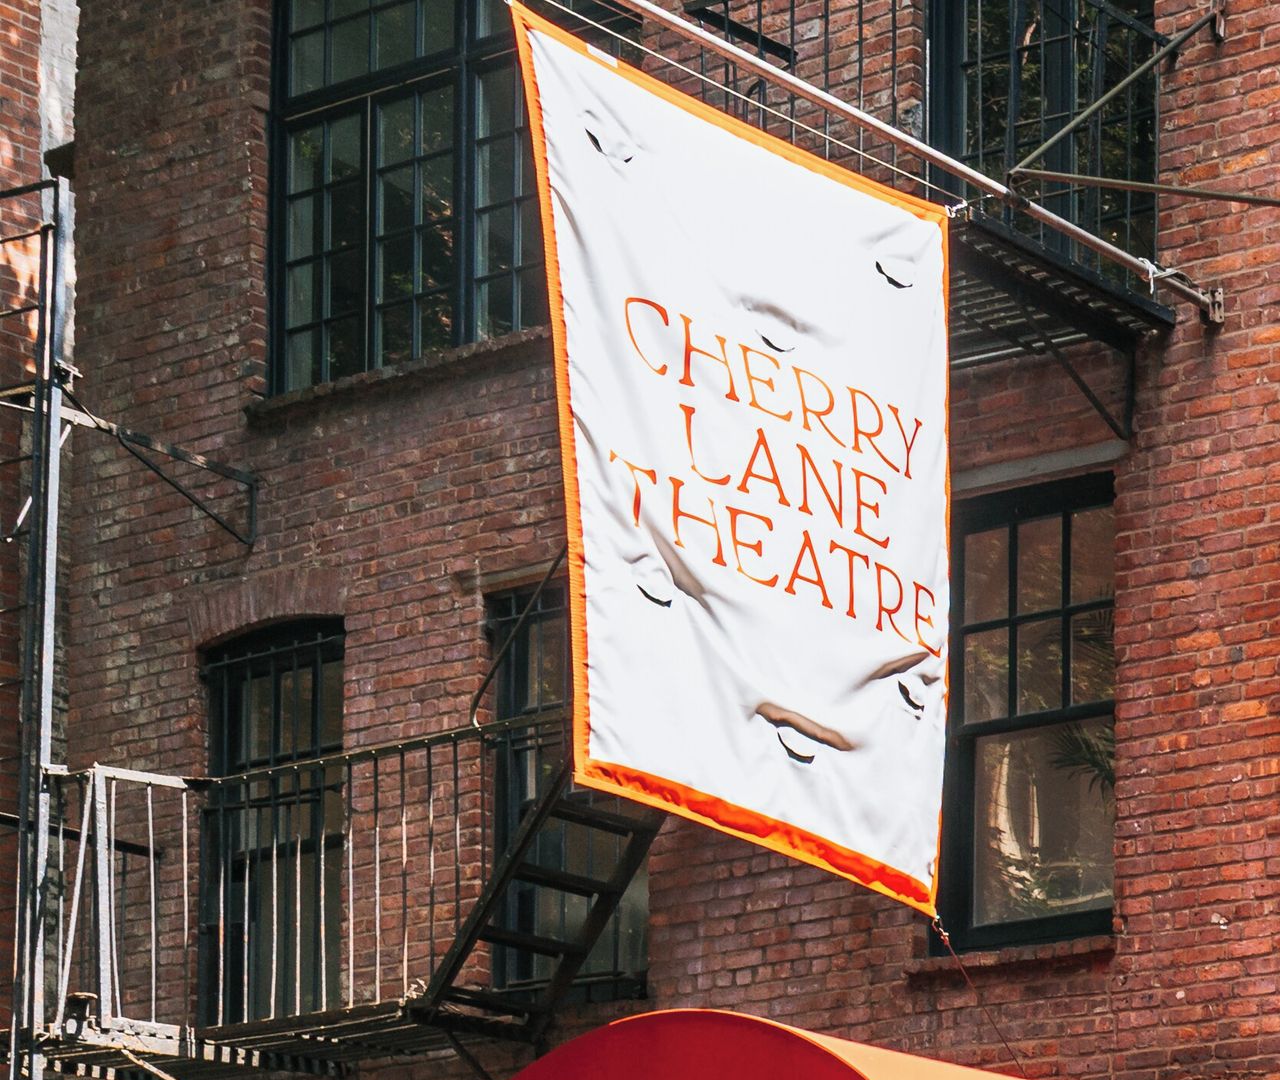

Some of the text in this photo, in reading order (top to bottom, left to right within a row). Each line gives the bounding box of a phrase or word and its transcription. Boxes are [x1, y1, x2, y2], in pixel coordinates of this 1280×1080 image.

[623, 296, 924, 479] CHERRY
[679, 404, 891, 549] LANE
[609, 450, 943, 658] THEATRE
